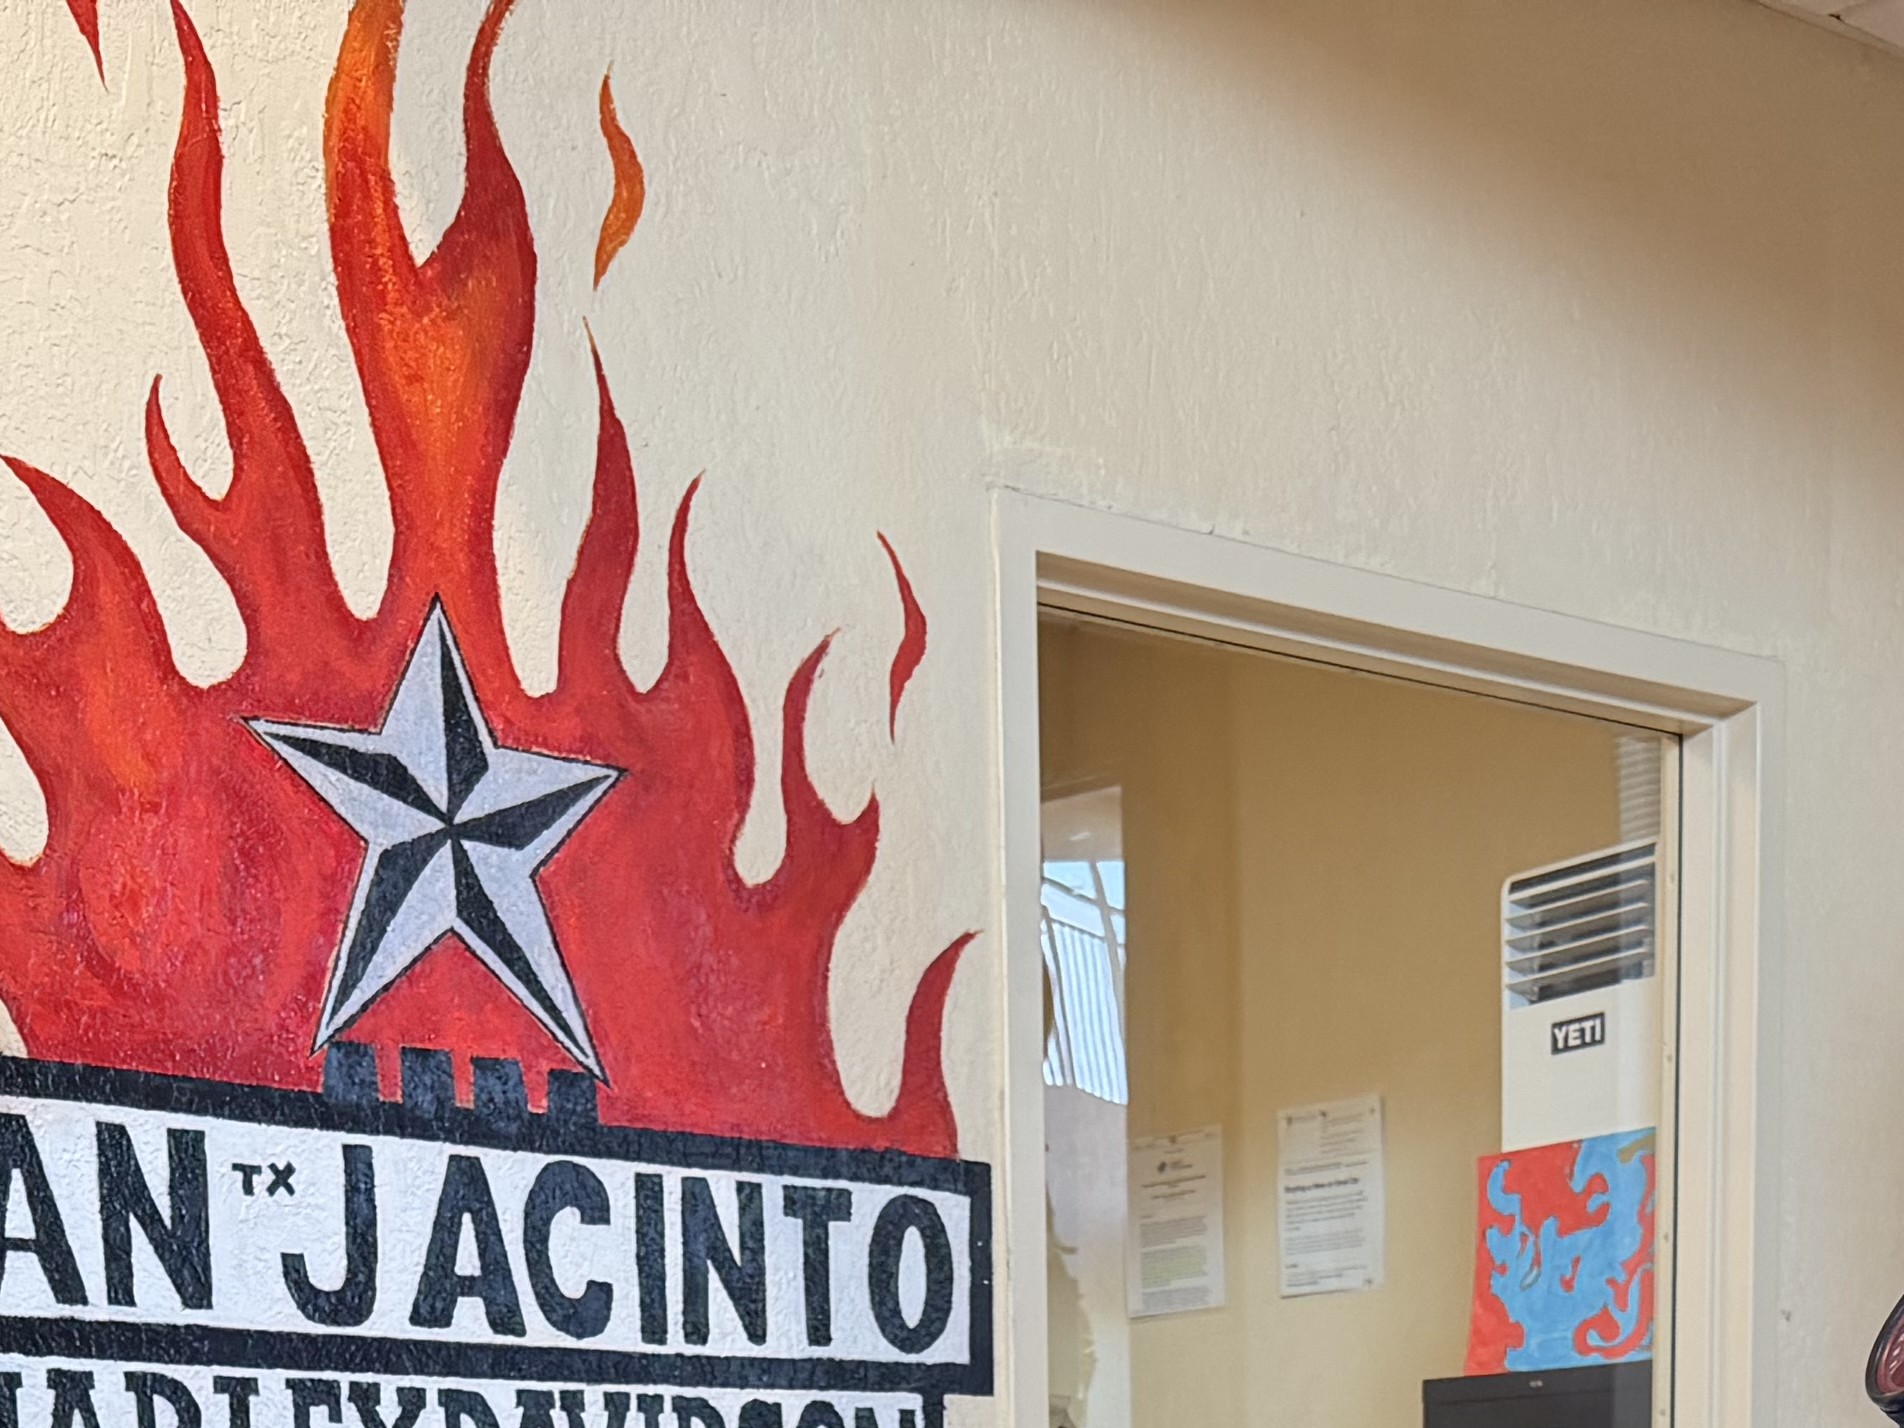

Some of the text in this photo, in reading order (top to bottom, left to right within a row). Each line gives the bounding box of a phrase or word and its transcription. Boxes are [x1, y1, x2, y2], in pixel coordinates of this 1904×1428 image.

[1551, 1018, 1604, 1052] YETI
[234, 1160, 298, 1200] TX
[280, 1142, 956, 1358] JACINTO
